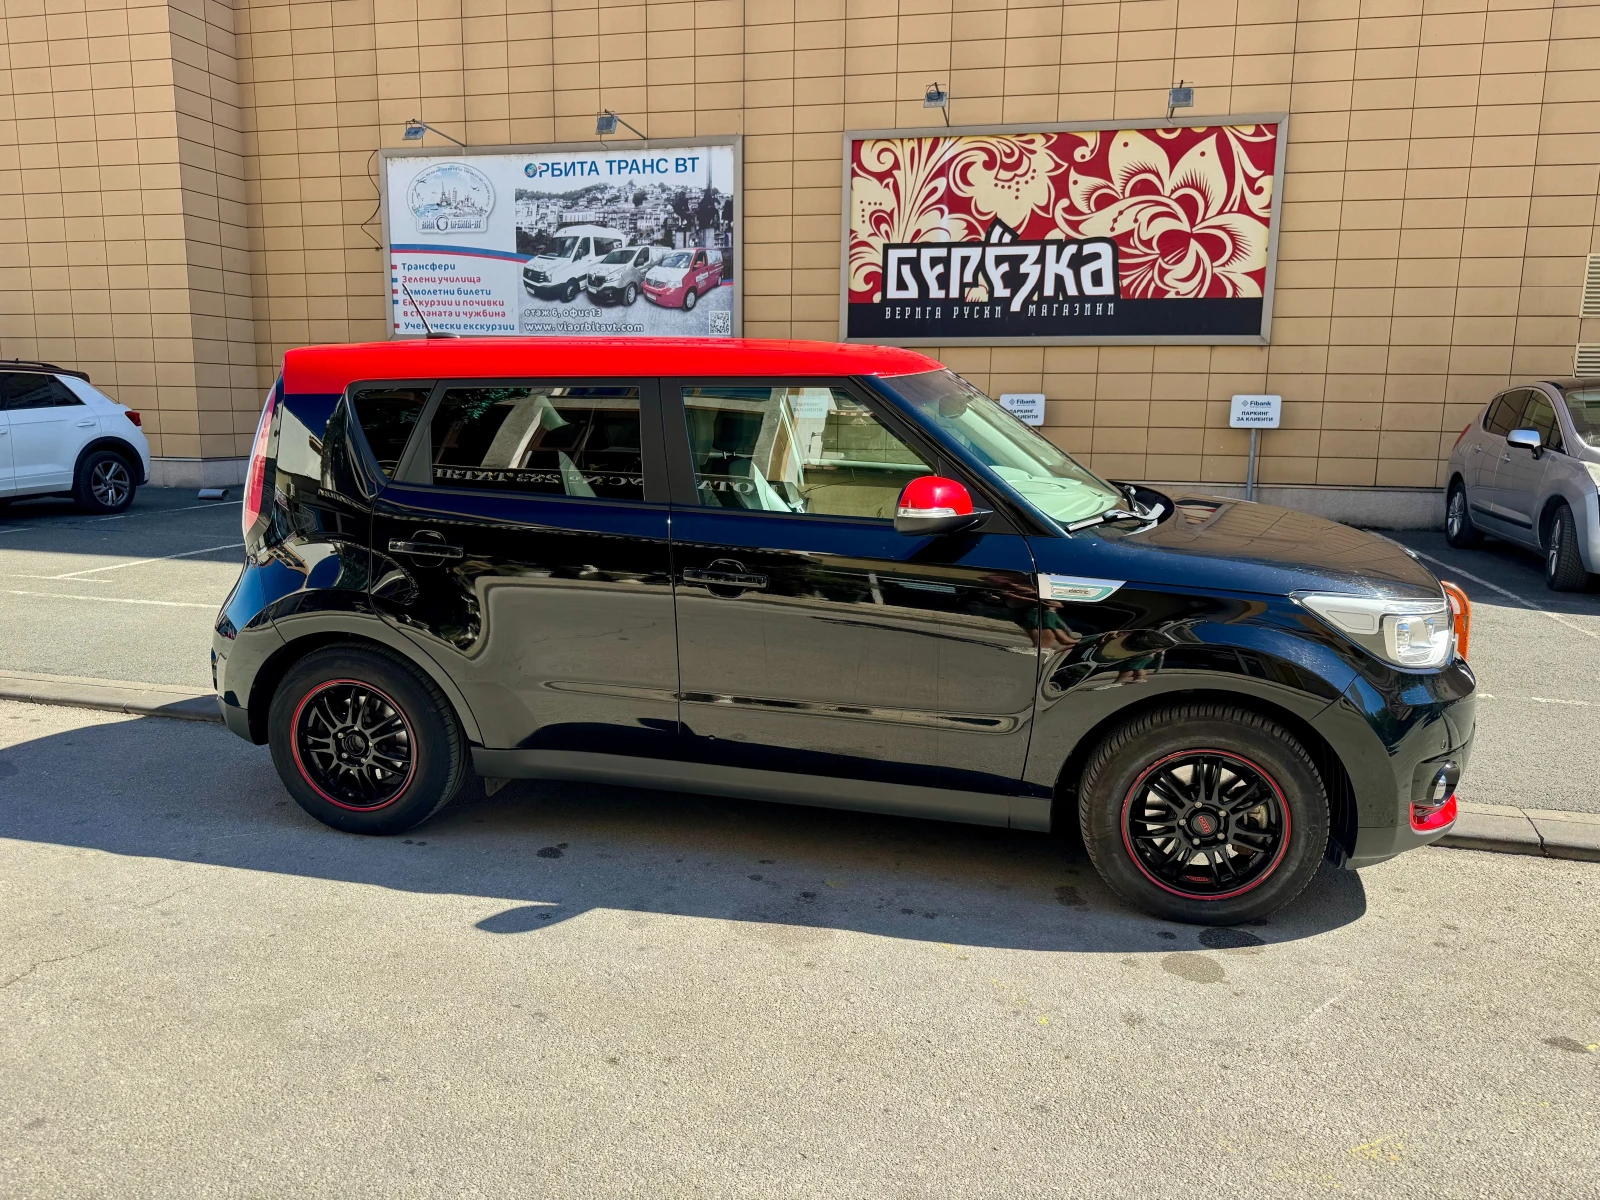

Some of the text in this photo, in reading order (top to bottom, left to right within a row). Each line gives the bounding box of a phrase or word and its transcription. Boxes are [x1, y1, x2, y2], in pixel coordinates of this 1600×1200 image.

[524, 156, 700, 178] ОРБИТА ТРАНС ВТ
[401, 262, 456, 272] Трансфери
[402, 275, 481, 285] Зелени училища
[402, 287, 491, 296] Самолетни билети
[462, 309, 506, 319] чужбина
[523, 308, 550, 318] етаж
[550, 308, 562, 319] 6,
[885, 303, 1115, 319] ВЕРИГА РУСКИ МАГАЗИНИ
[463, 322, 515, 332] екскурзии
[557, 320, 645, 333] viaorbitavt.com
